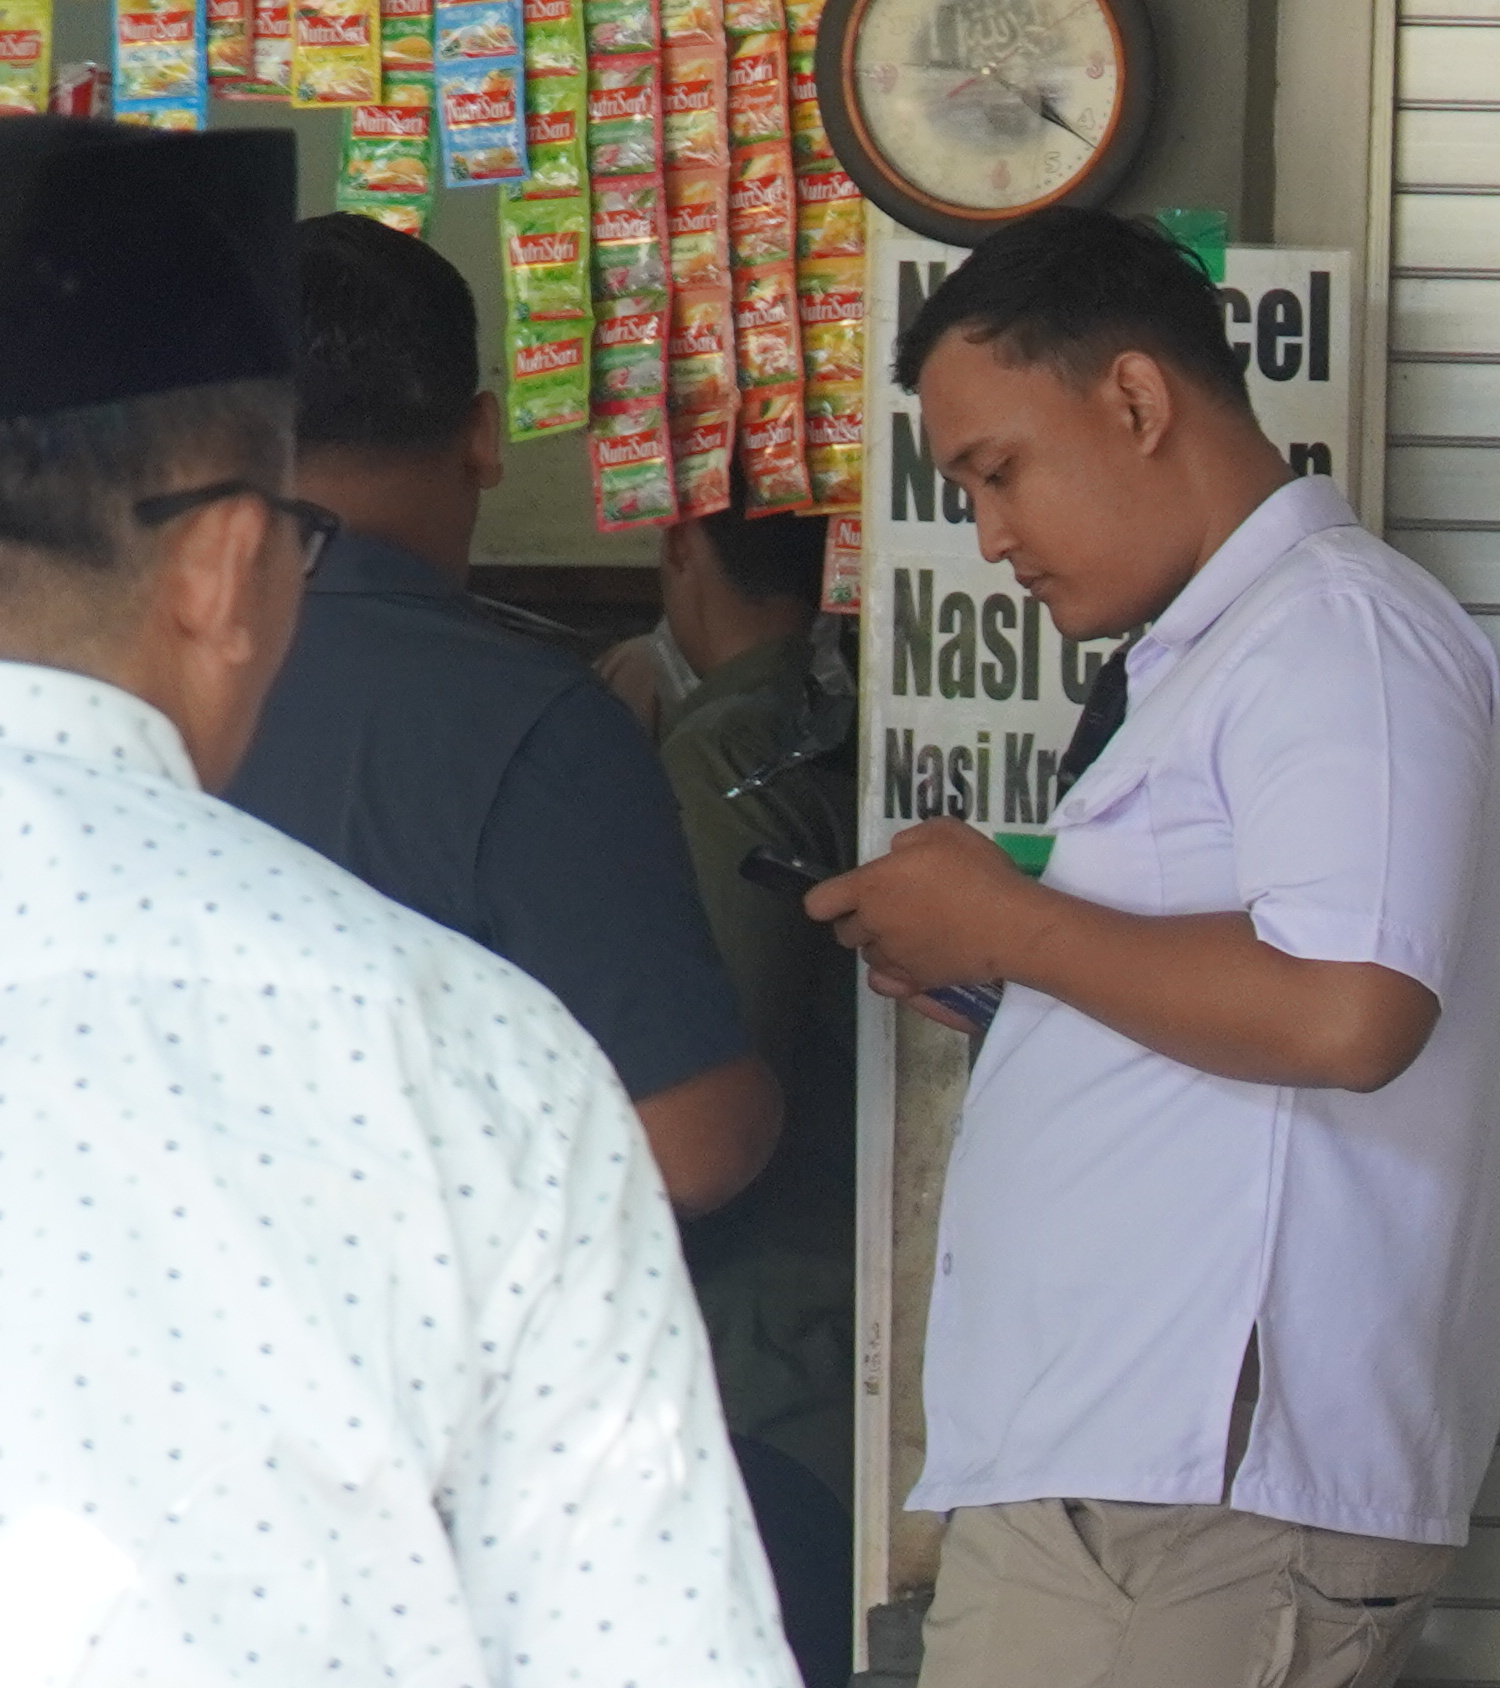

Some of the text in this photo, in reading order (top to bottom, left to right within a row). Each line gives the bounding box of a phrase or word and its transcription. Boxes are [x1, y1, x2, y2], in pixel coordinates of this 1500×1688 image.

[1220, 271, 1331, 382] cel
[893, 568, 1040, 700] Nasi
[883, 727, 990, 822] Nasi
